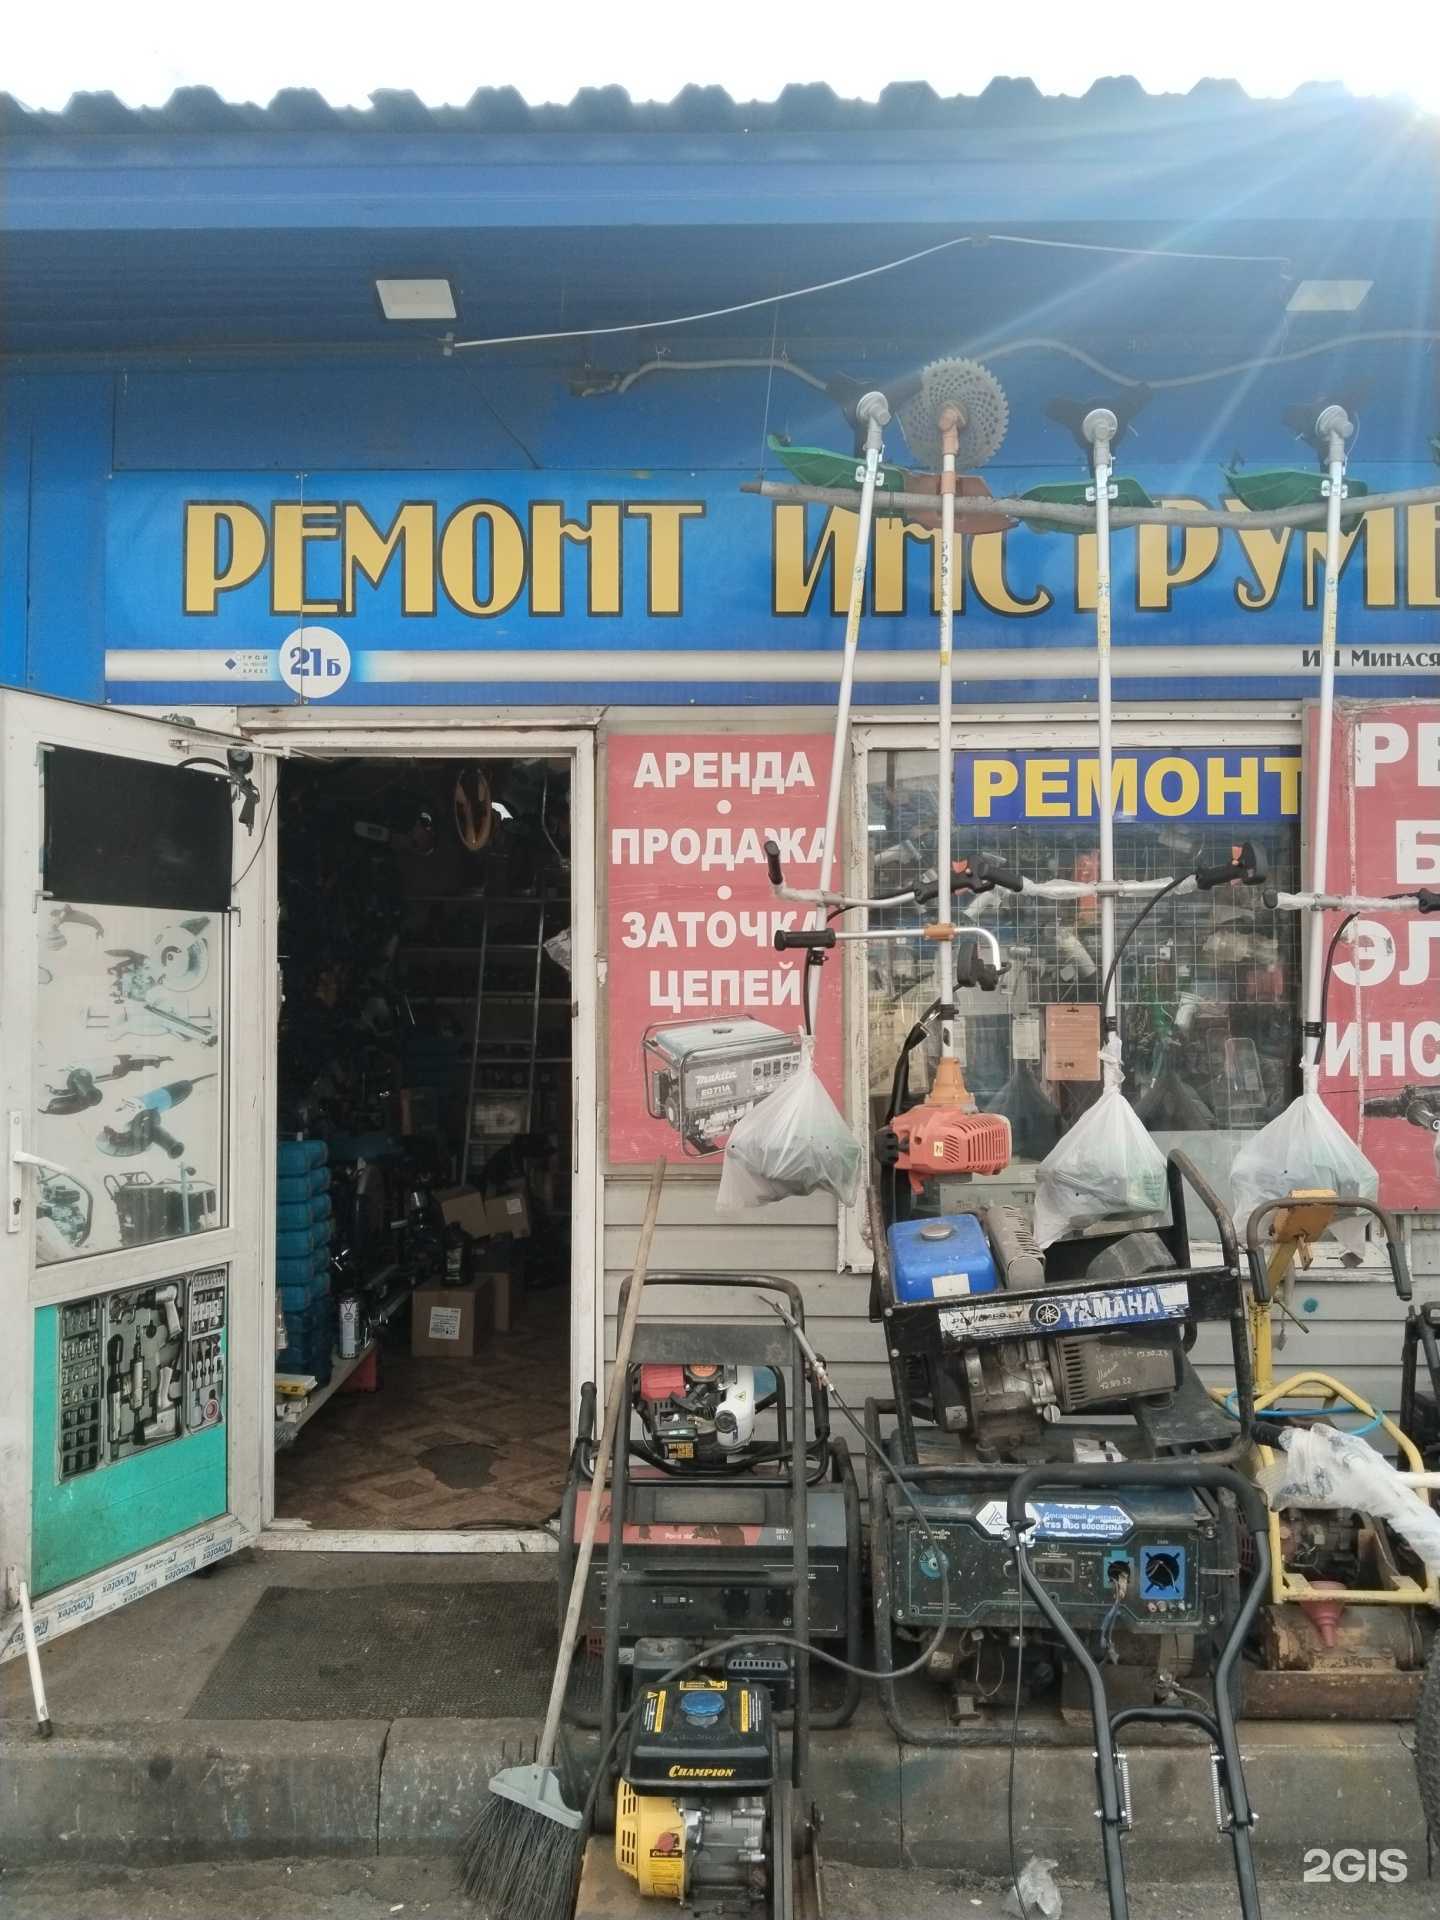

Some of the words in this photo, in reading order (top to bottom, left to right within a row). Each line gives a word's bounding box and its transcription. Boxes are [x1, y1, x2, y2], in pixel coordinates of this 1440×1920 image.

[183, 499, 706, 617] РЕМОНТ
[633, 752, 815, 795] АРЕНДА
[972, 757, 1301, 818] РЕМОНТ
[611, 828, 837, 871] ПРОДАЖА
[649, 961, 801, 1013] ЦЕПЕЙ
[1065, 1293, 1161, 1322] YAMAHA
